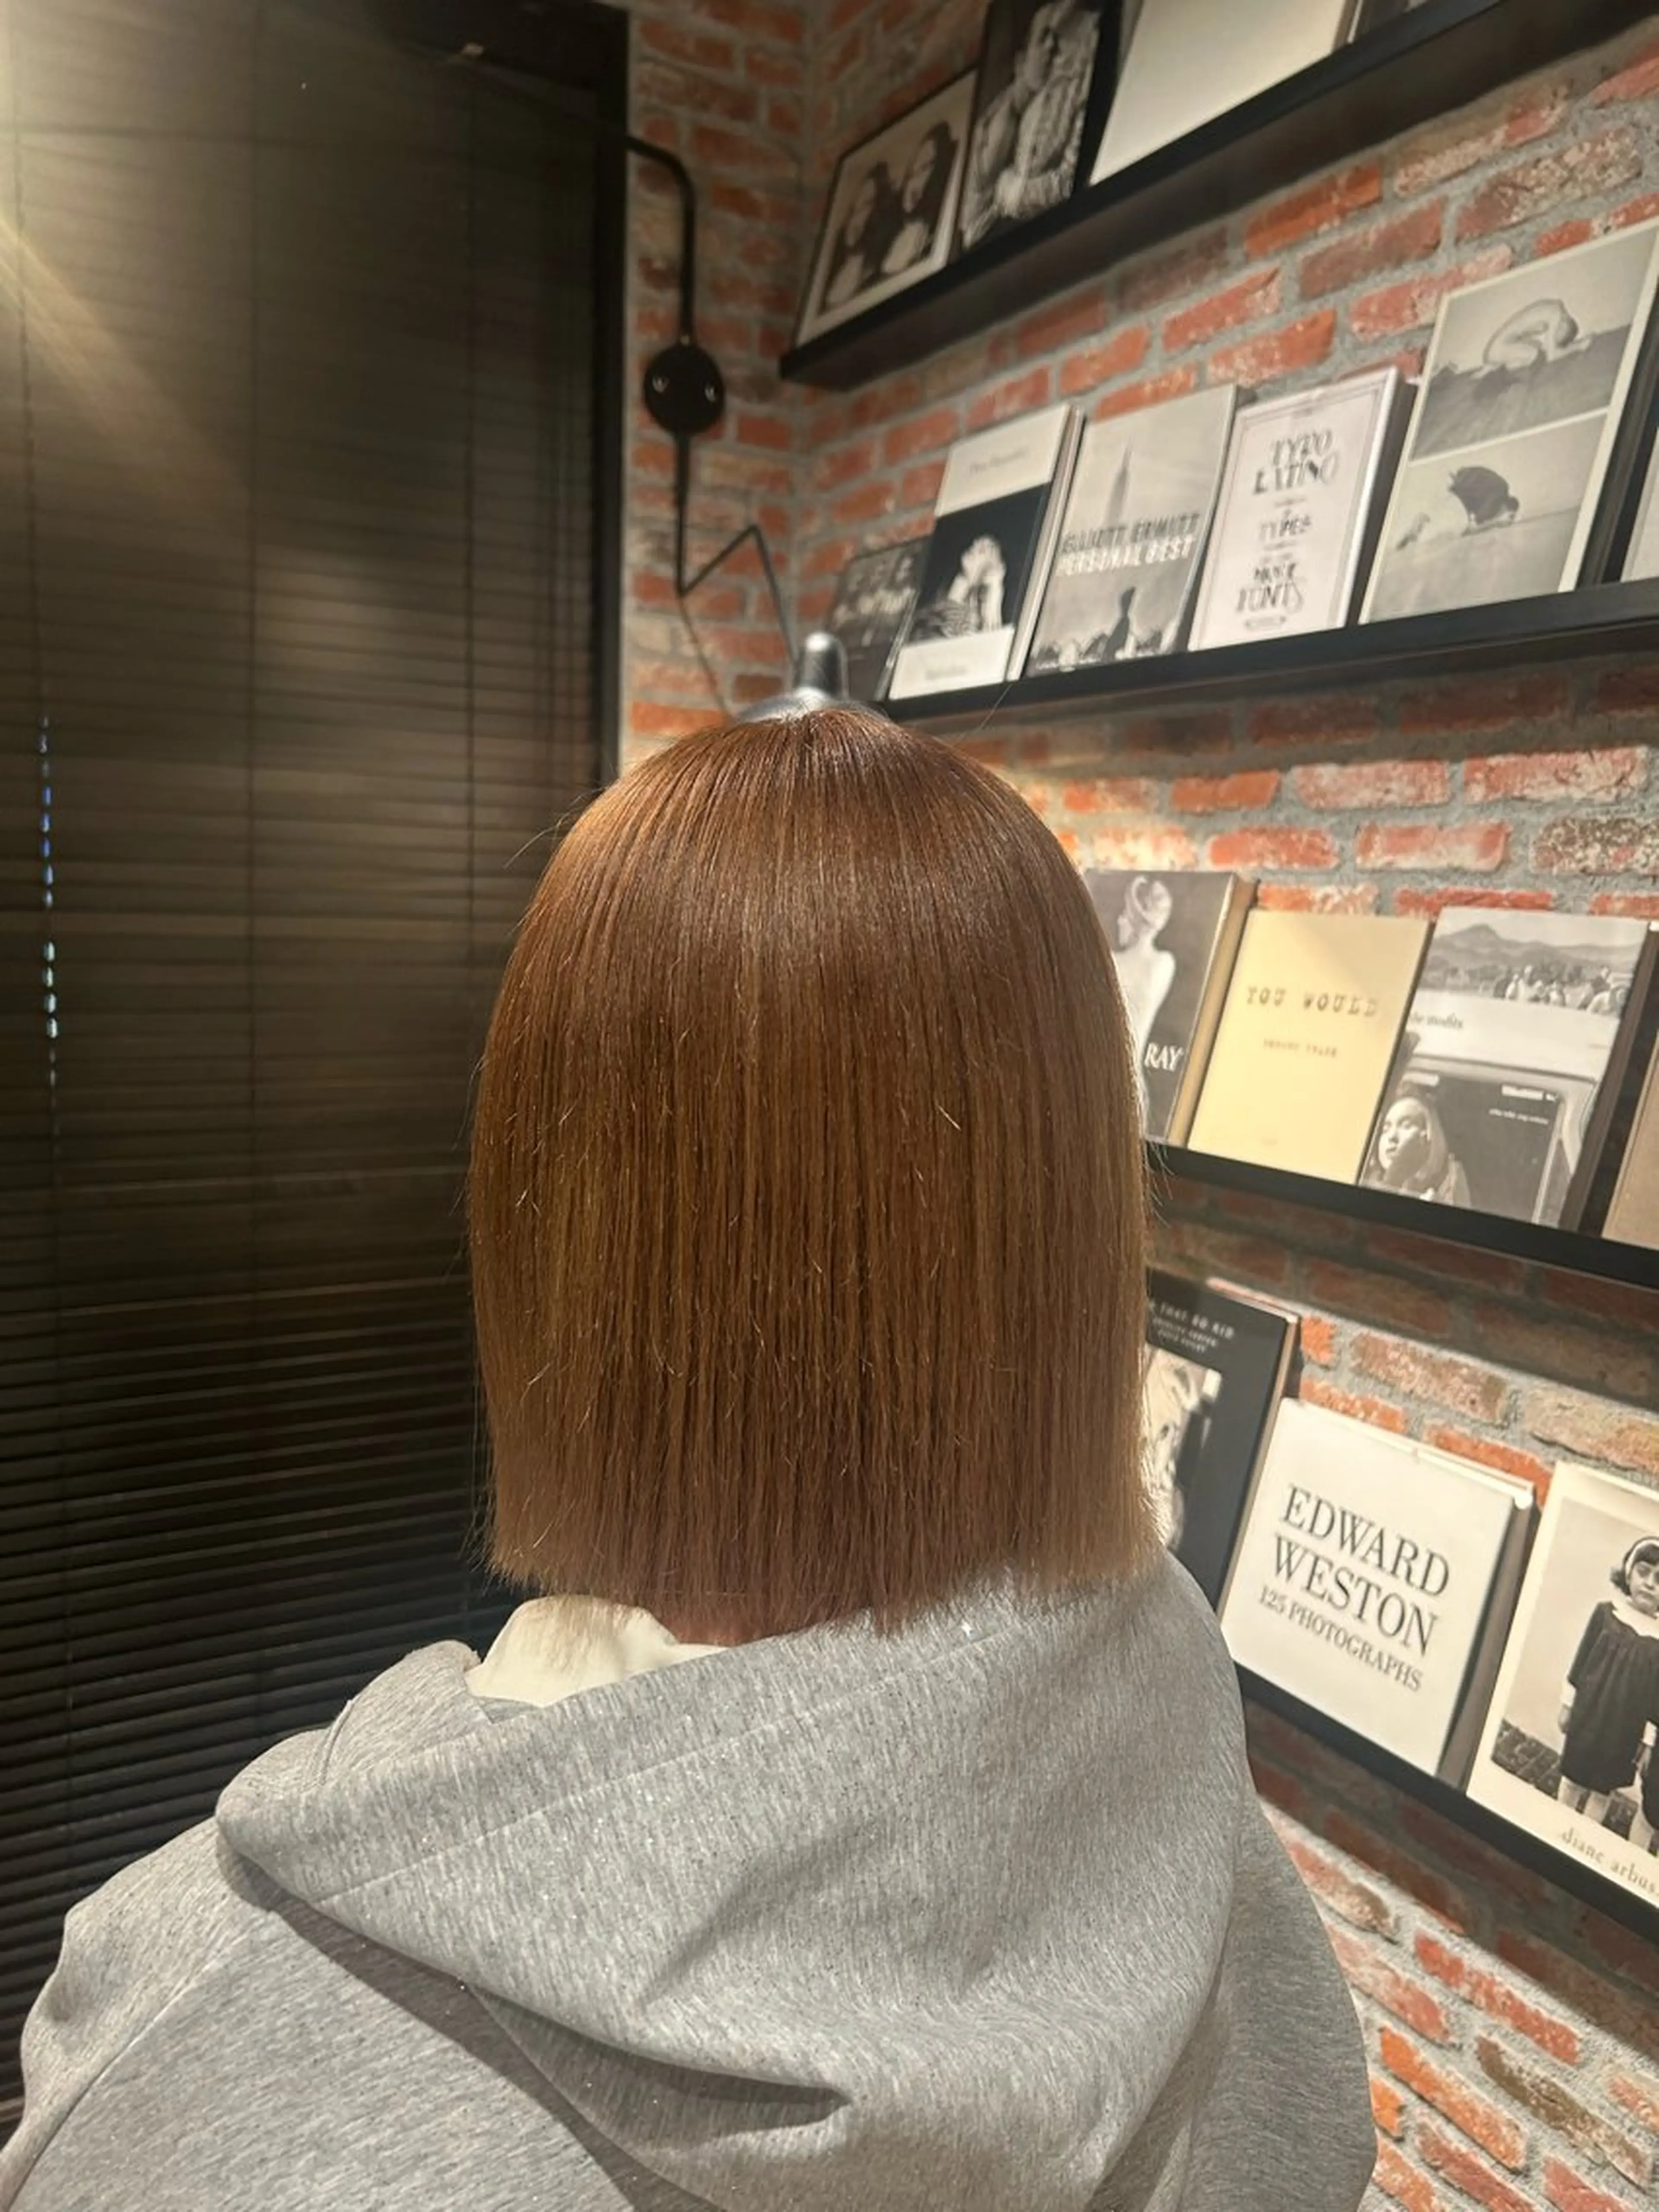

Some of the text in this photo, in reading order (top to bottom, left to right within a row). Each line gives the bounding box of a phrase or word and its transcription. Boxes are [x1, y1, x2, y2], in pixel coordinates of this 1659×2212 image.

[1055, 532, 1197, 577] PERSONAL BEST
[1246, 985, 1379, 1018] YOU WOULD
[1144, 1042, 1184, 1073] RAY
[1280, 1483, 1450, 1598] EDWARD
[1274, 1533, 1439, 1657] WESTON
[1258, 1585, 1424, 1693] 125 PHOTOGRAPHS
[1561, 1827, 1605, 1864] diane
